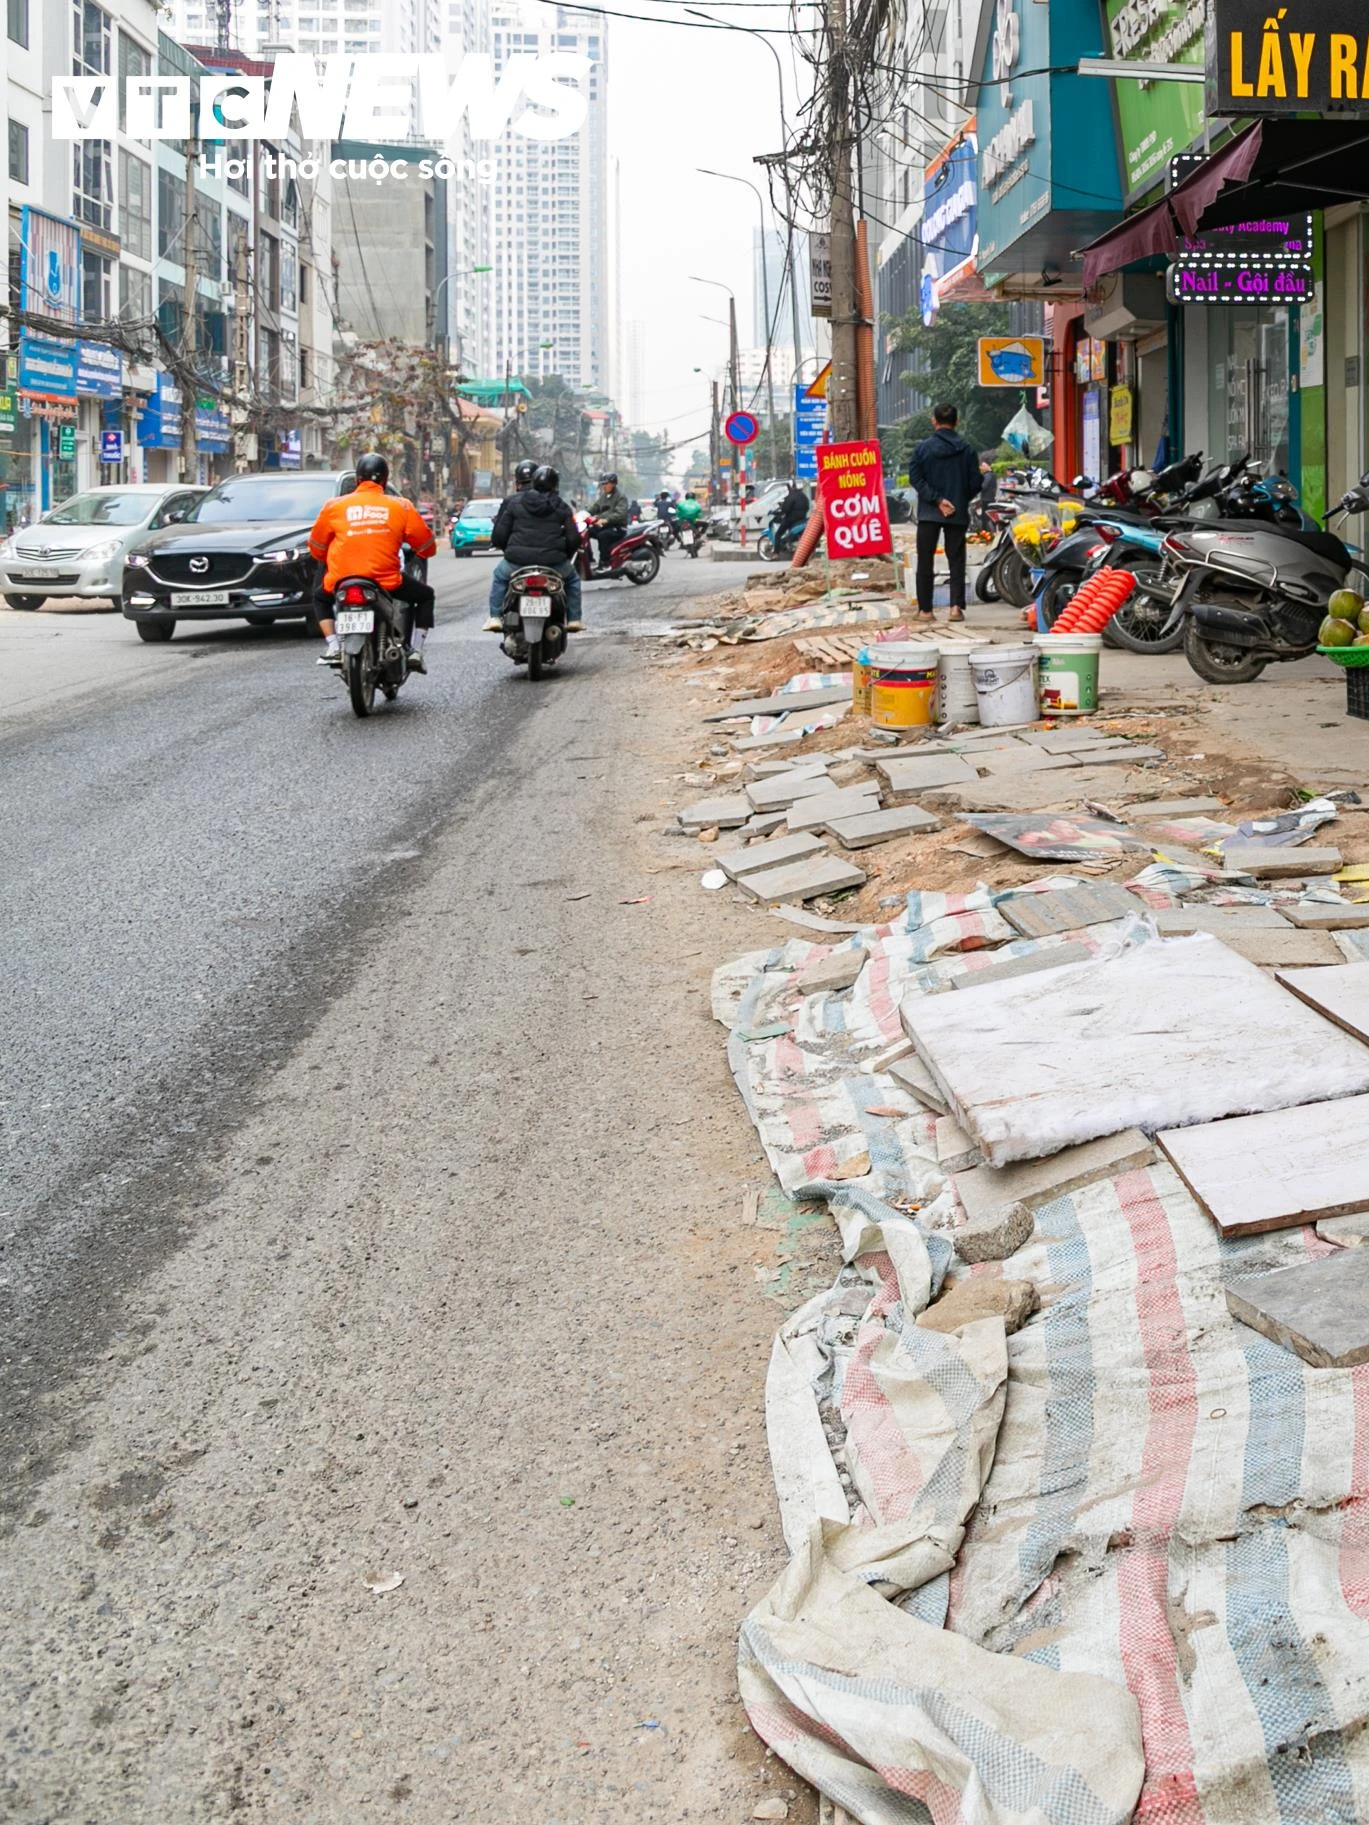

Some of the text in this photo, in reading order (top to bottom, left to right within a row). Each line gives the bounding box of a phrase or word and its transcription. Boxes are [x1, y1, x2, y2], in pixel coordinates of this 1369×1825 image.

[1231, 8, 1315, 98] LẤY
[1181, 270, 1306, 295] Nail Gội đầu
[823, 449, 877, 470] BÁNH CUỐN
[838, 470, 867, 489] NÓNG
[830, 492, 880, 519] CƠM
[834, 518, 884, 549] QUÊ
